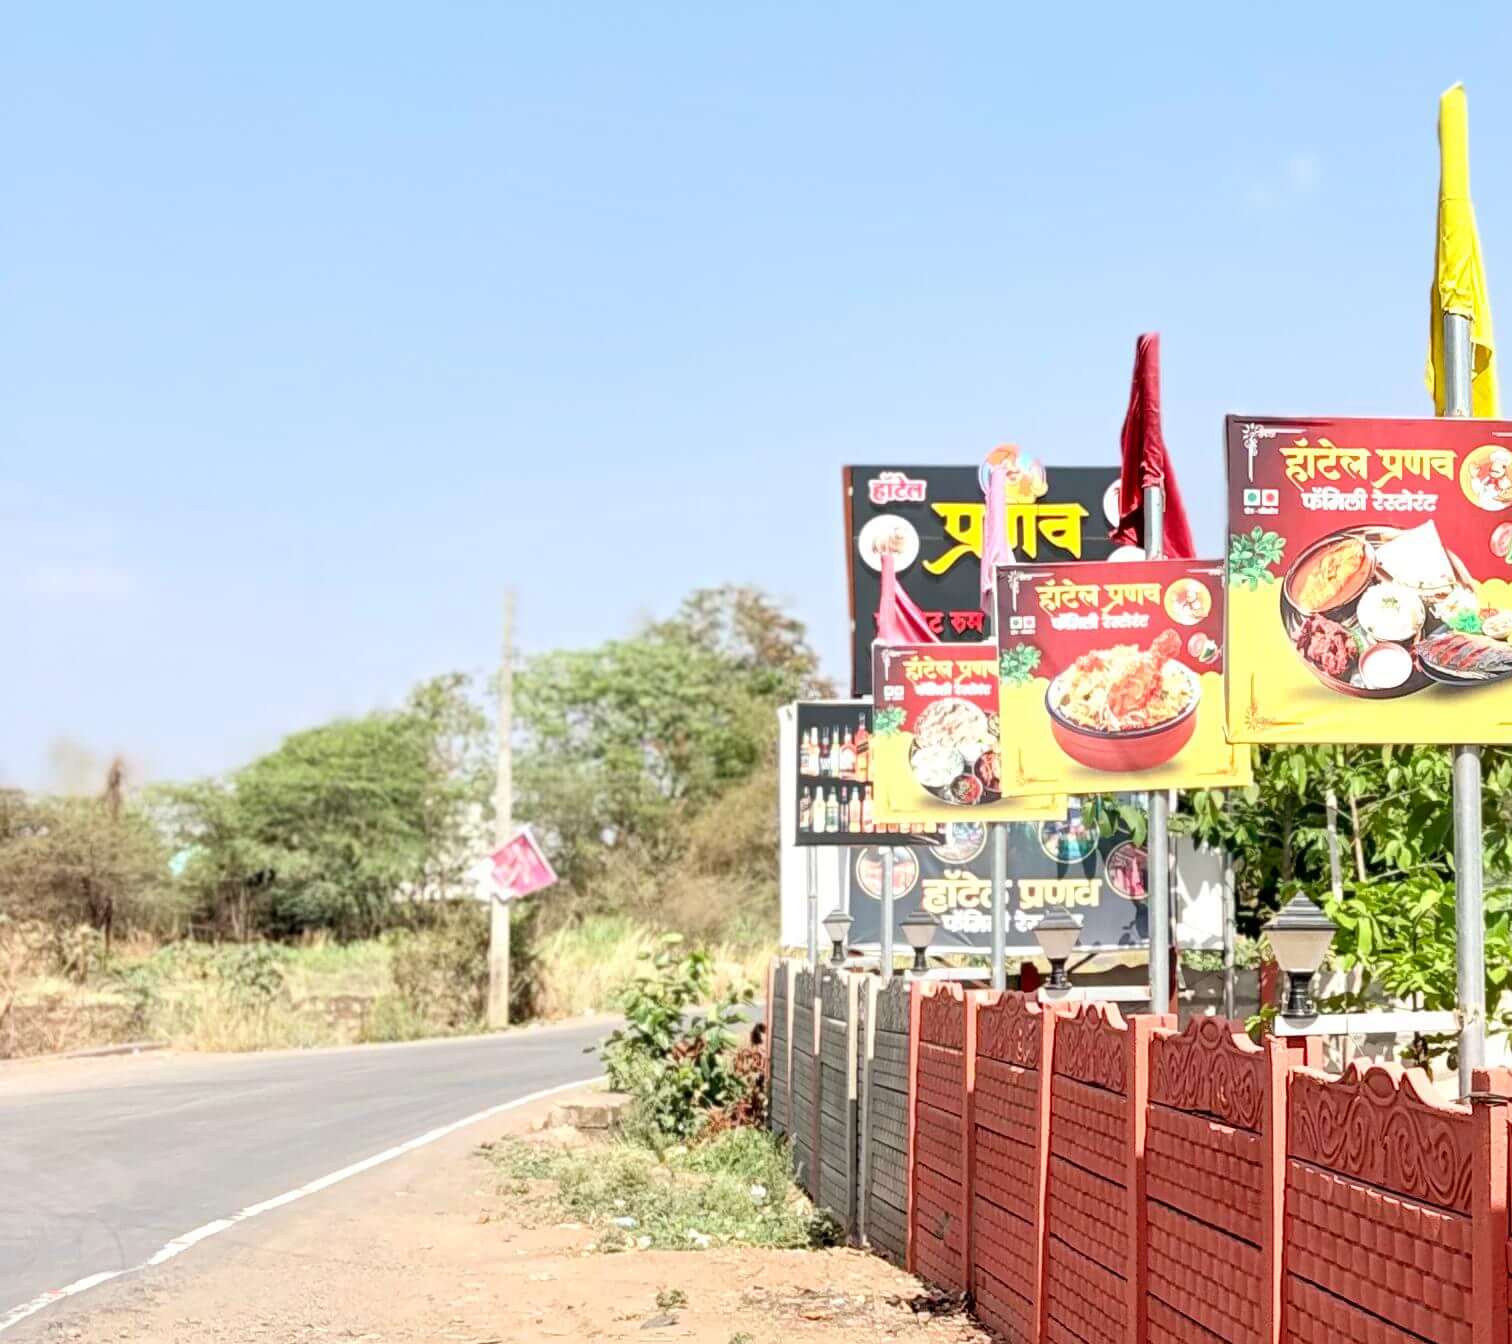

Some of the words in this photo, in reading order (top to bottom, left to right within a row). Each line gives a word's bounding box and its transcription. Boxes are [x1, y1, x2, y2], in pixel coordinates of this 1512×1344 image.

[1279, 438, 1371, 492] हॉटेल
[1370, 449, 1458, 488] प्रणव
[868, 472, 927, 504] हॉटेल
[1034, 578, 1101, 617] हॉटेल
[1101, 583, 1161, 613] प्रणव
[1017, 878, 1102, 909] प्रणव
